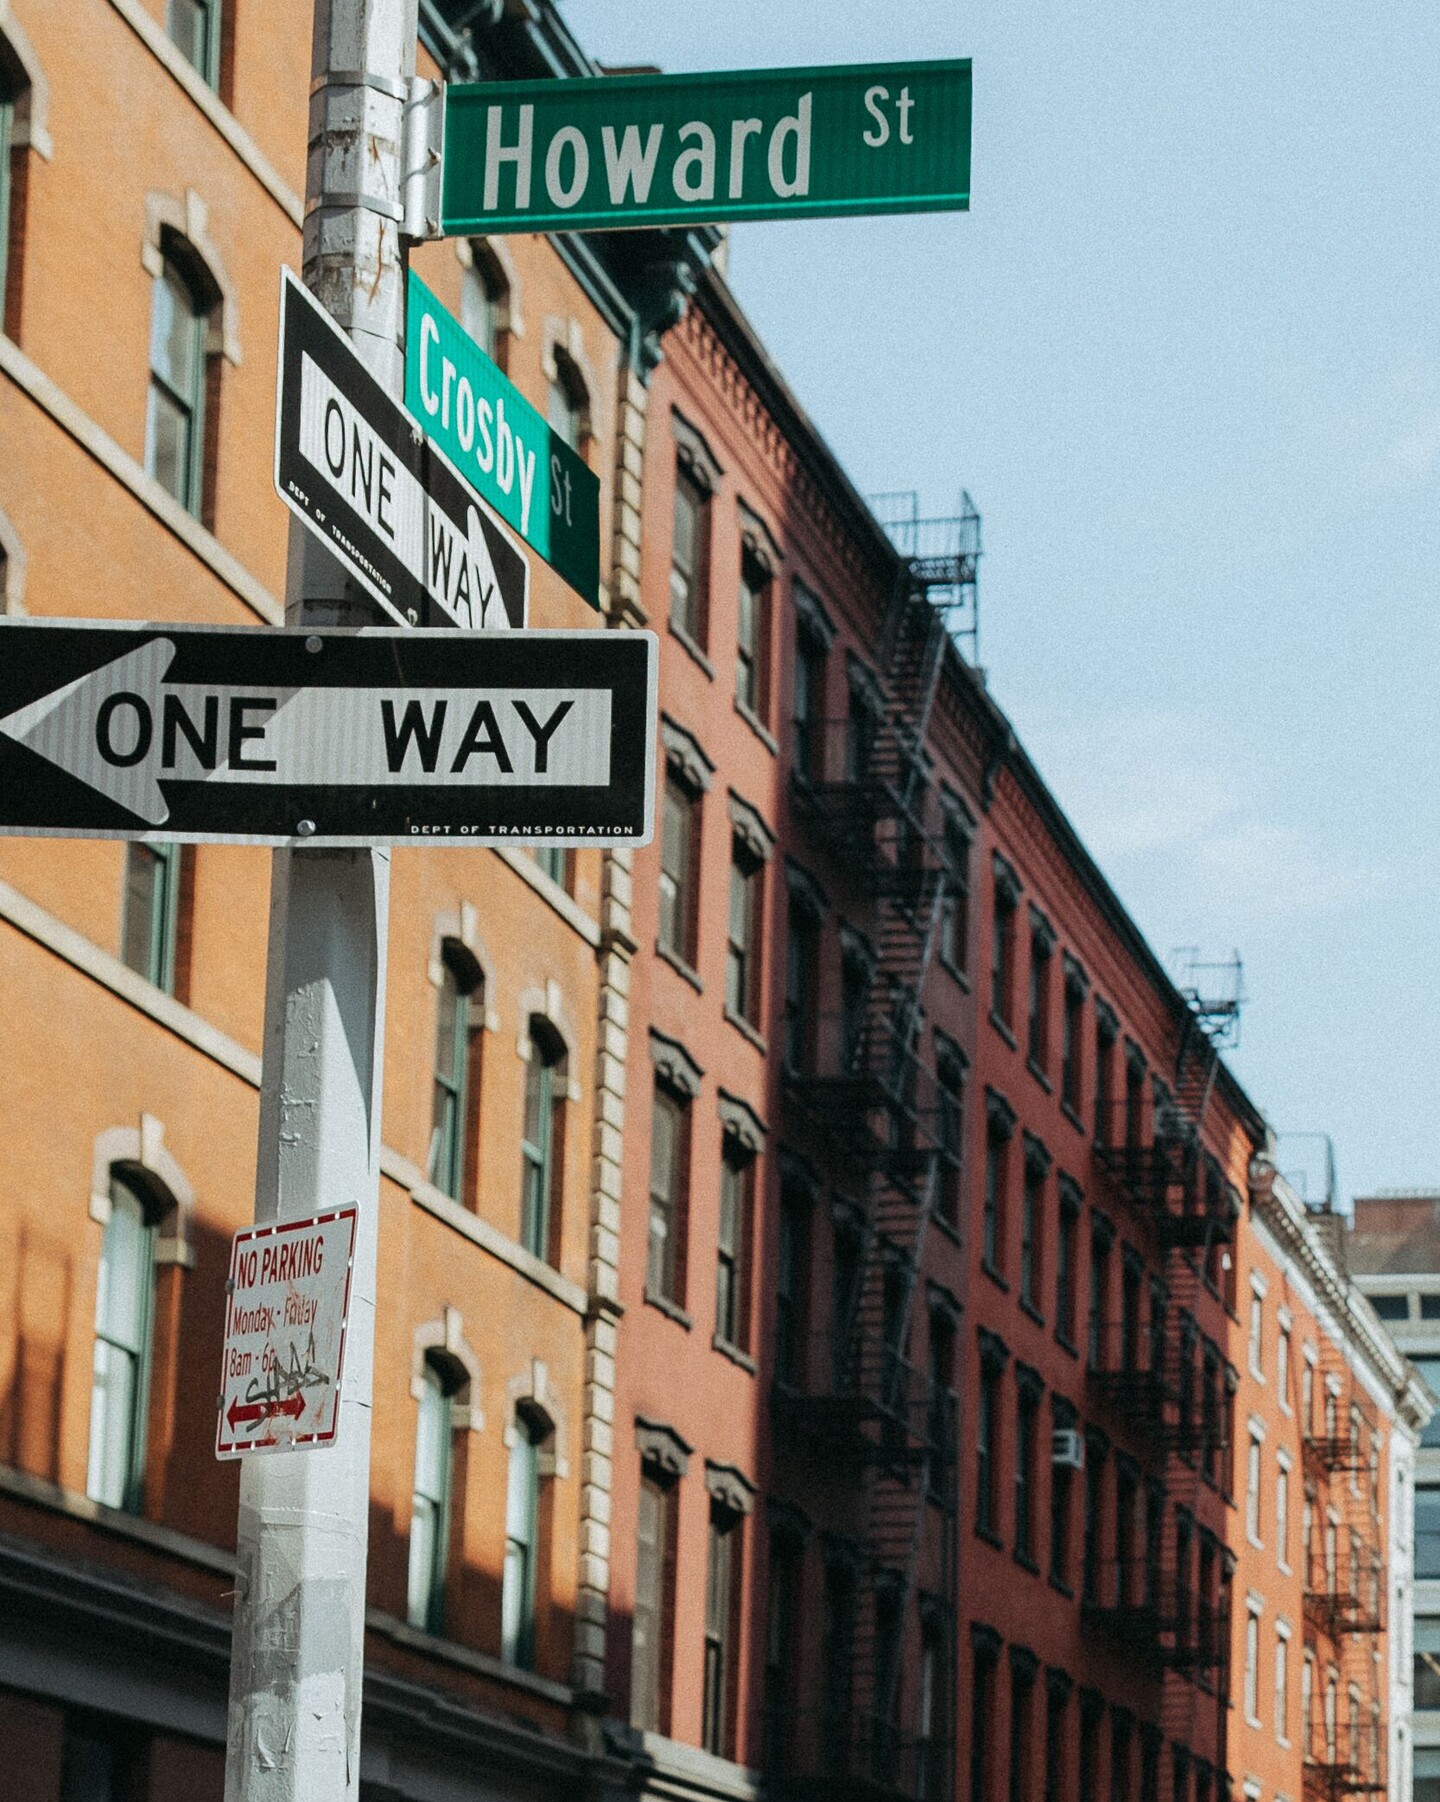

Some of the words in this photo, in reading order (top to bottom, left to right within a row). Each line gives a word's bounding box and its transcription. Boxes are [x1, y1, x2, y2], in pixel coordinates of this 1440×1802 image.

[482, 91, 813, 211] Howard
[862, 86, 915, 148] St
[418, 312, 536, 537] Crosby
[551, 453, 573, 527] St
[288, 480, 310, 506] DEPT
[315, 508, 327, 522] OF
[332, 524, 392, 594] TRANSPORTATION
[324, 397, 396, 542] ONE
[428, 510, 496, 628] WAY
[94, 690, 278, 773] ONE
[380, 698, 576, 775] WAY
[410, 825, 451, 834] DEPT
[460, 825, 480, 834] OF
[489, 825, 634, 834] TRANSPORTATION
[236, 1250, 257, 1290] NO
[260, 1235, 324, 1286] PARKING
[233, 1301, 274, 1338] Monday
[229, 1347, 252, 1378] 8am
